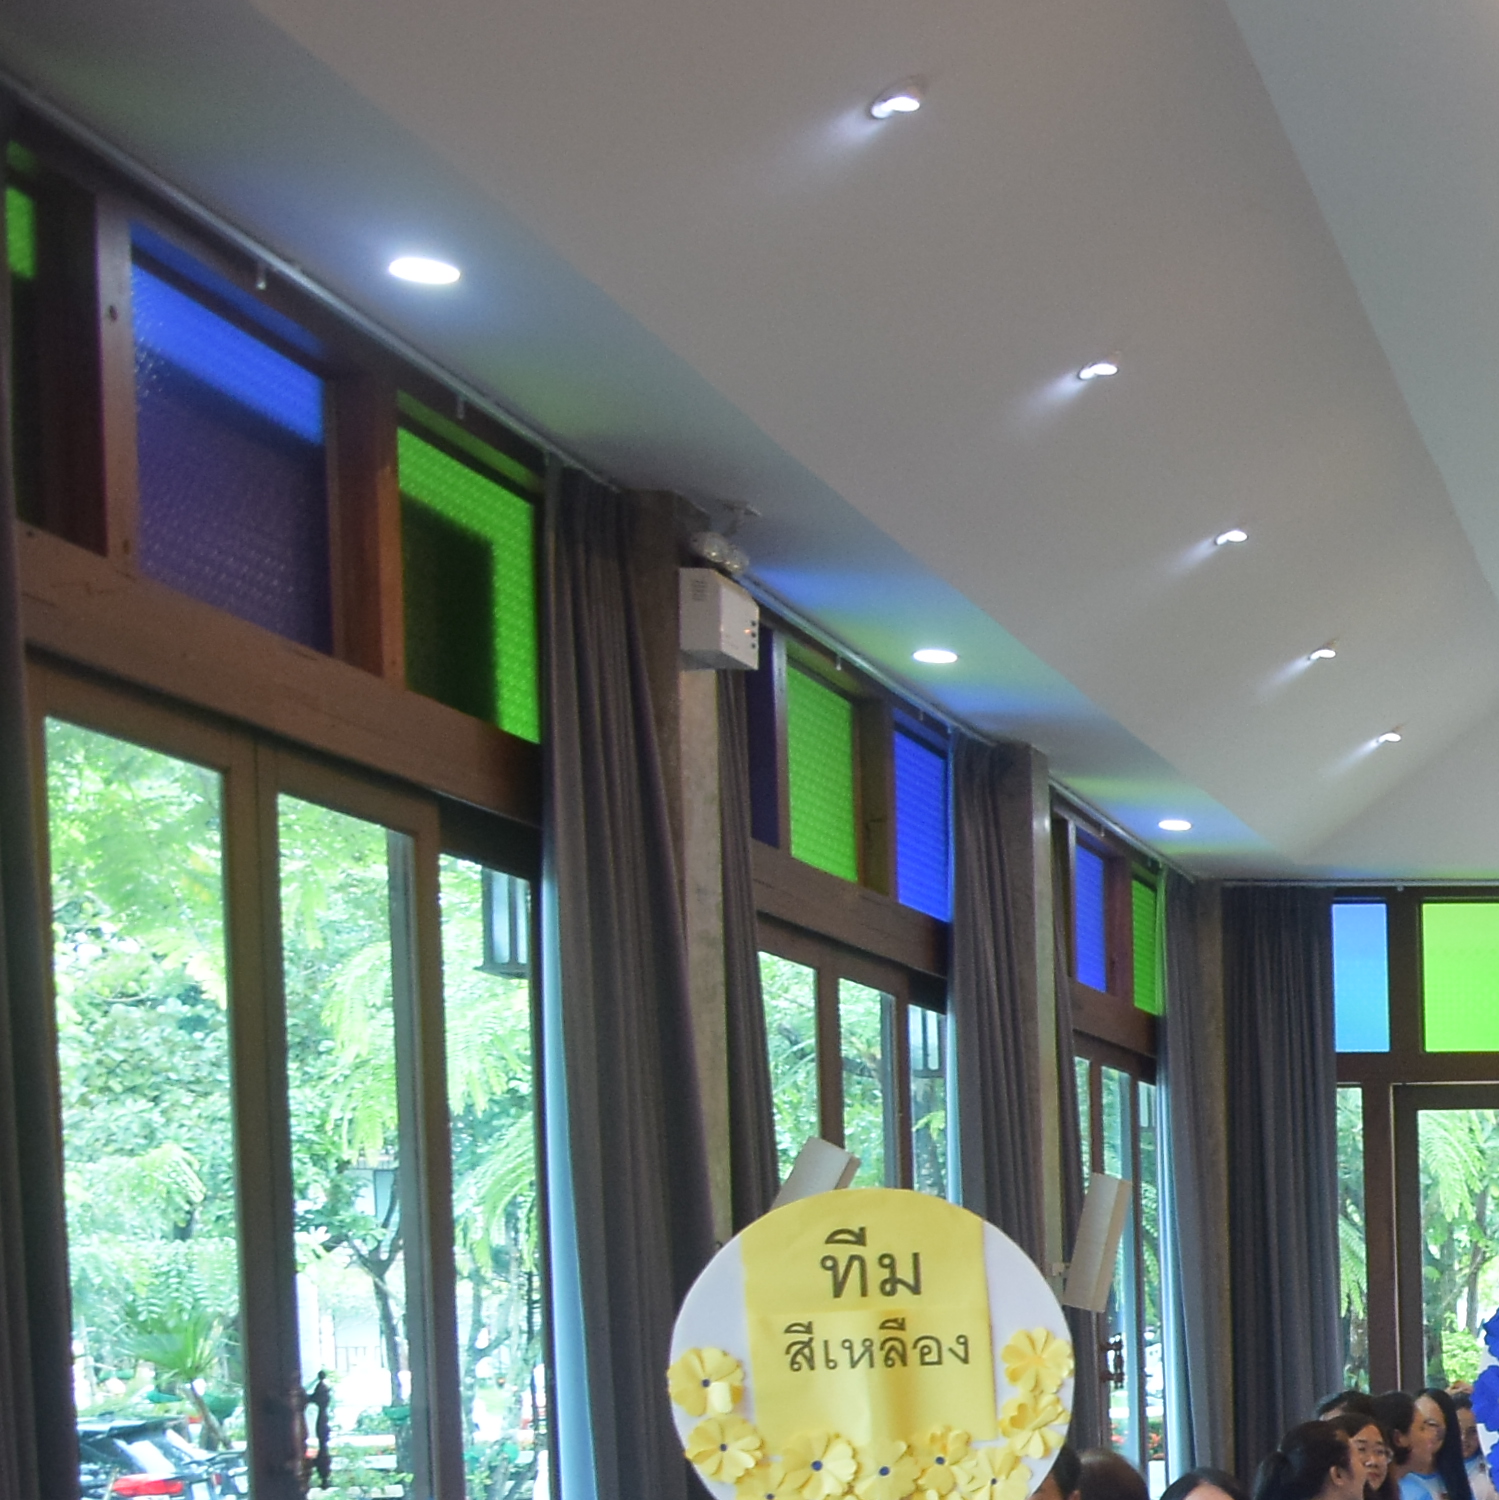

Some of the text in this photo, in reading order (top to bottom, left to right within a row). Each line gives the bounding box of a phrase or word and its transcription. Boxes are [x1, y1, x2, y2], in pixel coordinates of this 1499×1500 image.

[820, 1226, 922, 1298] ทีม
[784, 1317, 970, 1372] สีเหลือง
